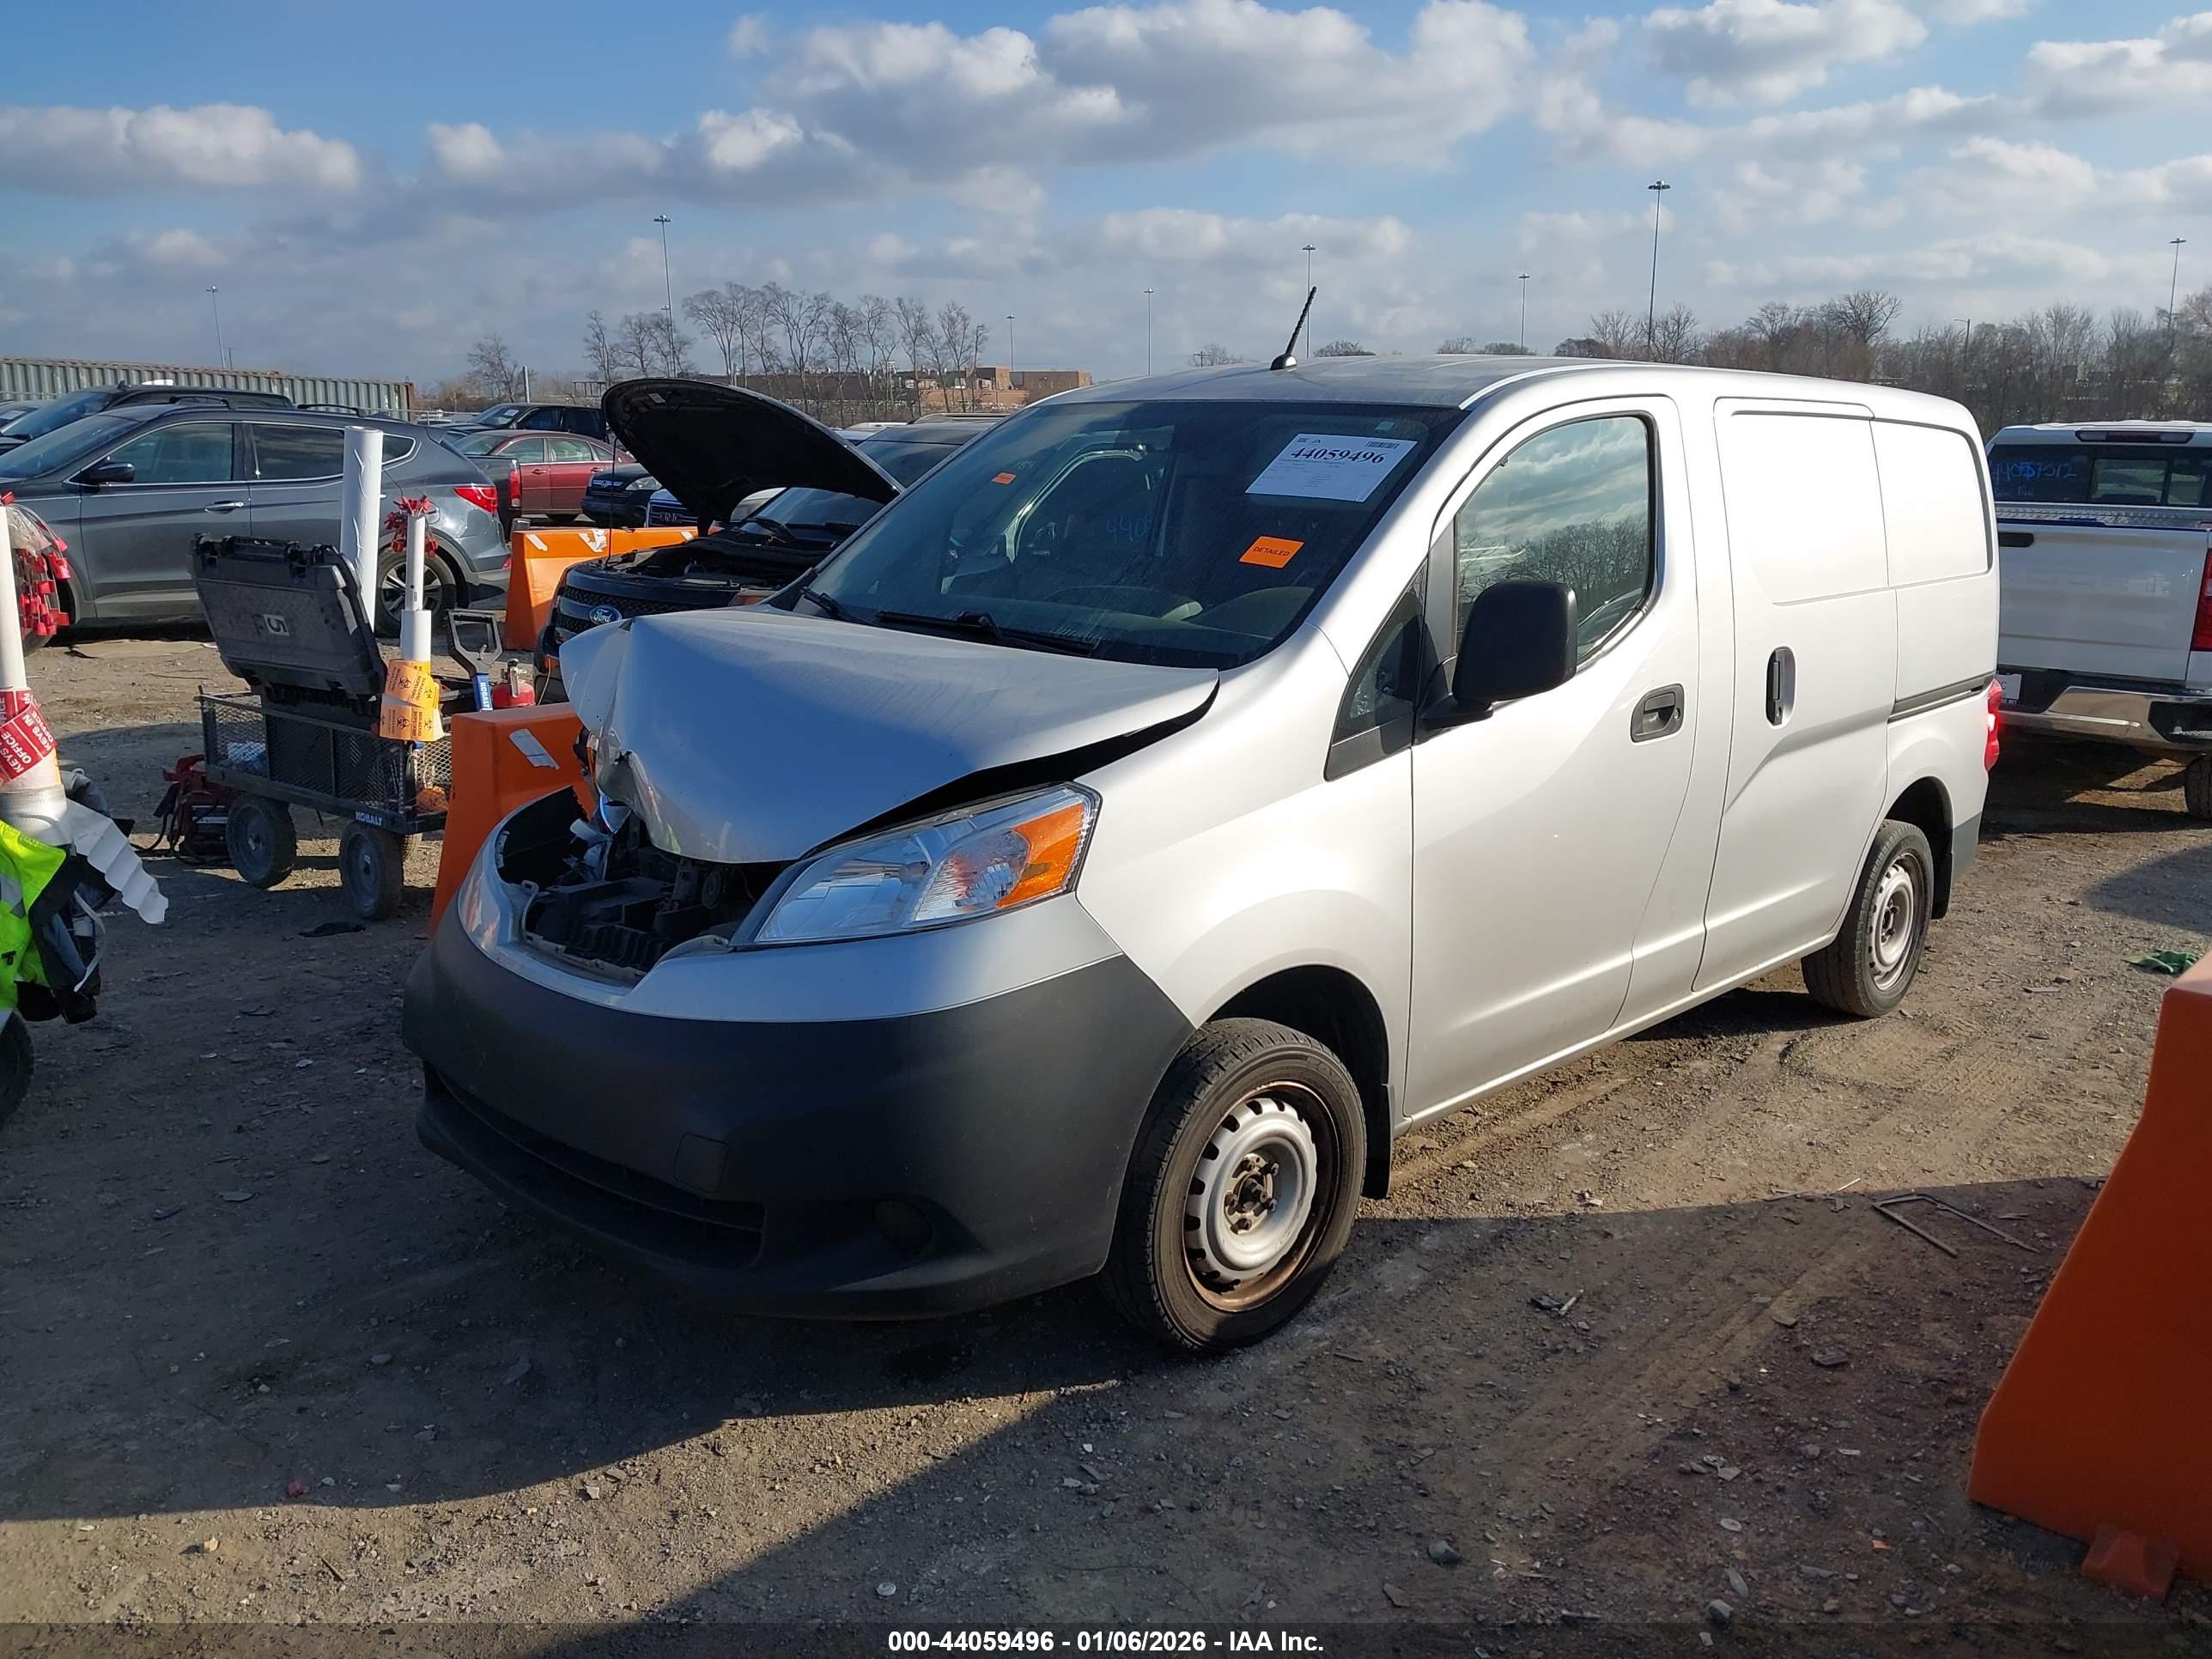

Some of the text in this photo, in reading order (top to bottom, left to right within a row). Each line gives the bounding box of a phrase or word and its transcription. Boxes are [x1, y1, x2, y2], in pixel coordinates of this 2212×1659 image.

[1291, 447, 1386, 464] 44059496
[1253, 546, 1290, 556] DETAILED
[267, 617, 288, 633] 5
[593, 609, 612, 623] Ford
[481, 682, 489, 708] KOBALT
[22, 714, 52, 751] KEYS IN
[31, 710, 54, 743] OFFICE
[1, 732, 32, 764] OFFICE
[0, 747, 24, 773] KEYS
[356, 811, 383, 826] KOBALT
